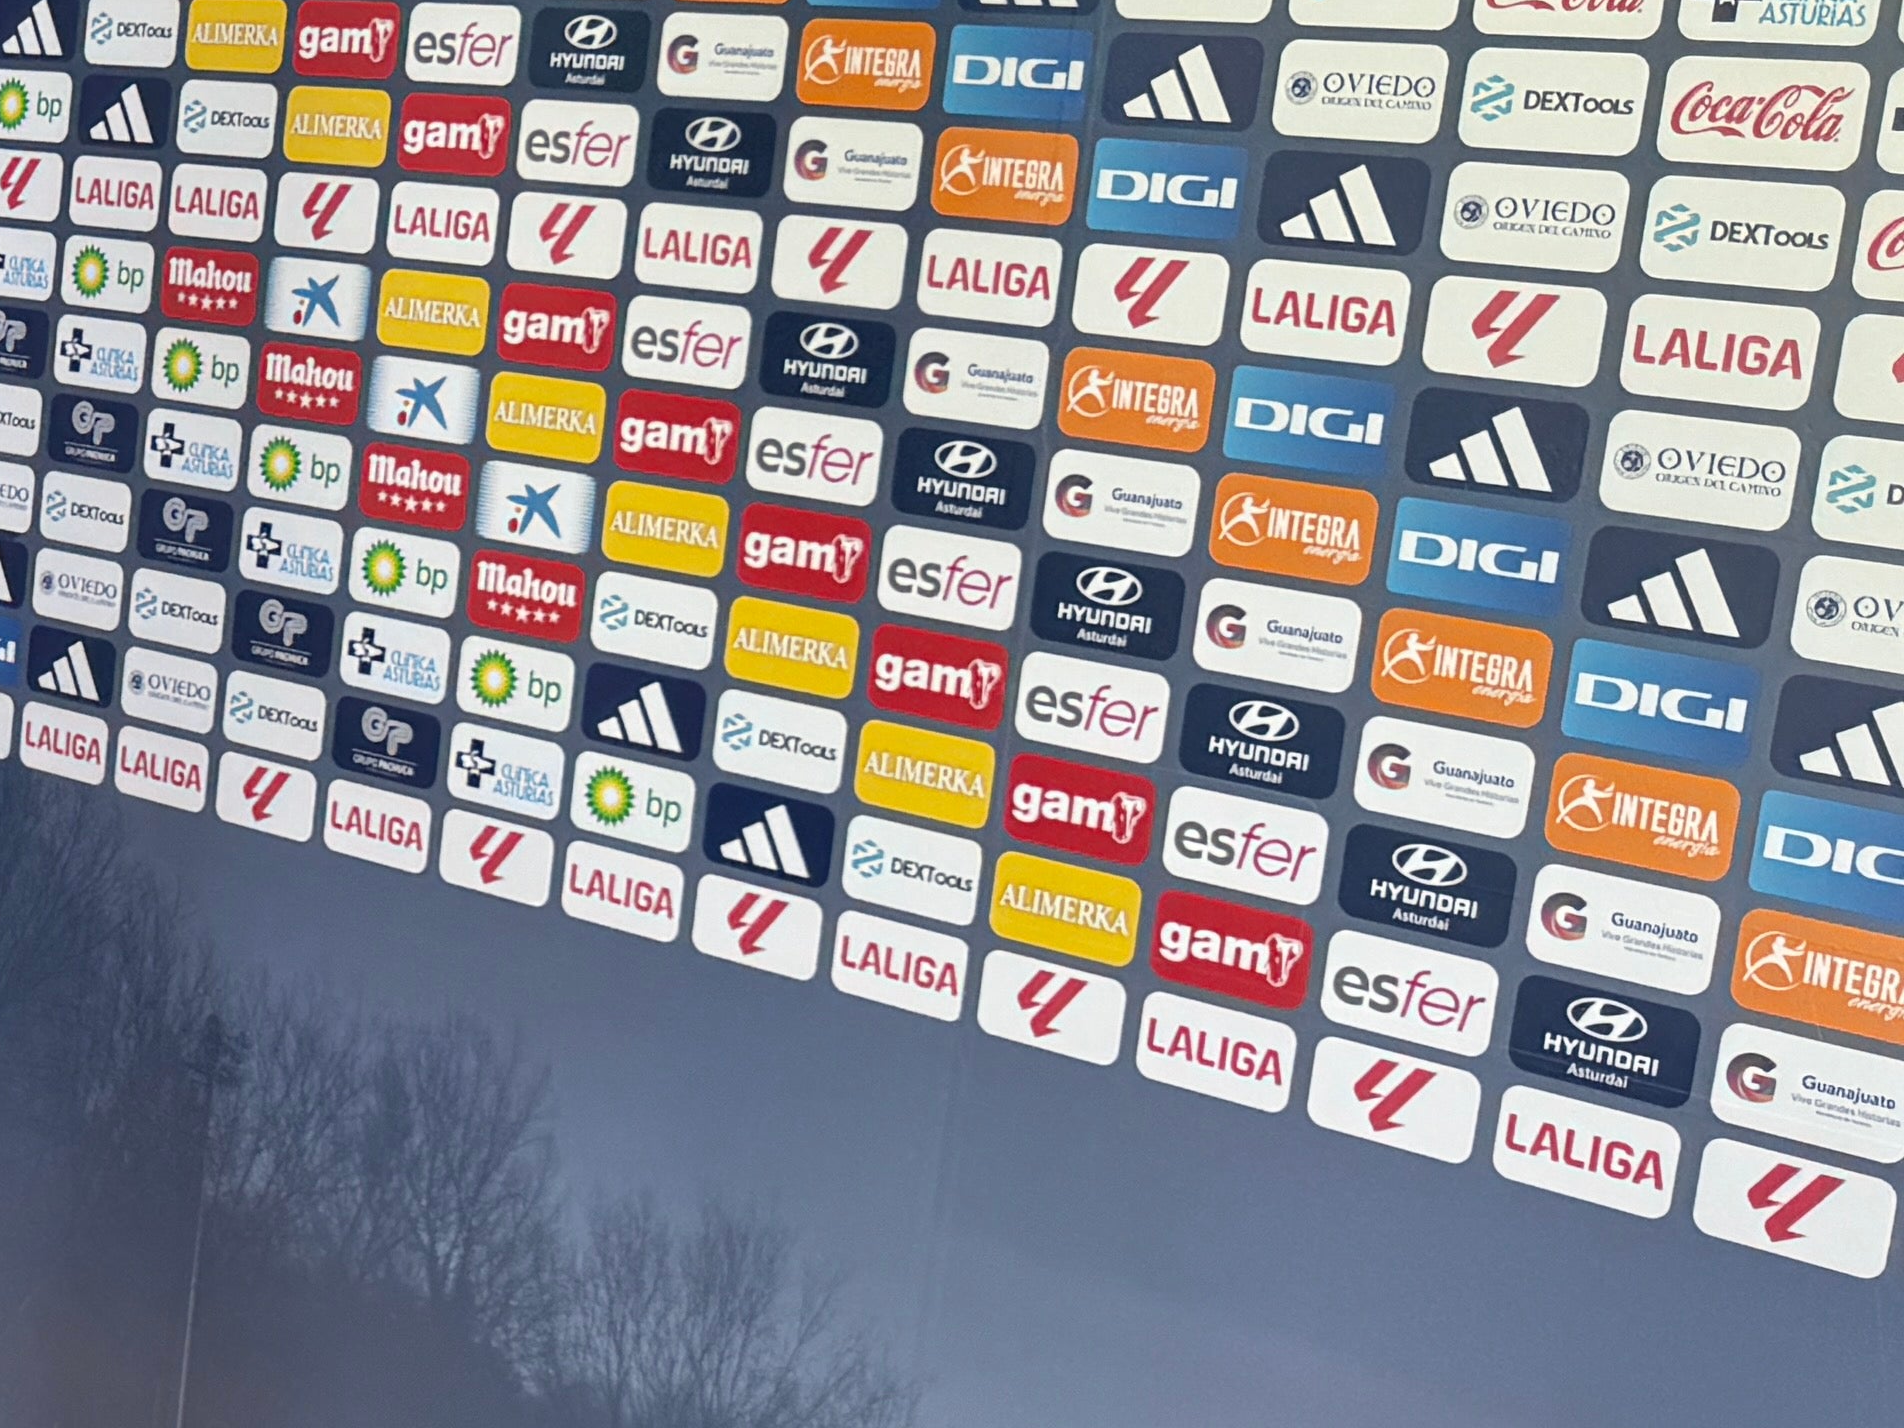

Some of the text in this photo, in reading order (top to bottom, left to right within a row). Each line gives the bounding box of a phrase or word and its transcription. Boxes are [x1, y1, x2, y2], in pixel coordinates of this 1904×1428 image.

[191, 21, 279, 47] ALIMERKA
[412, 22, 513, 67] esfer
[549, 51, 624, 71] HYUNDAI
[952, 54, 1085, 91] DIGI
[1323, 72, 1435, 98] OVIEDO
[289, 112, 382, 140] ALIMERKA
[524, 120, 630, 168] esfer
[669, 153, 749, 175] HYUNDAI
[981, 156, 1064, 192] INTEGRA
[74, 175, 154, 211] LALIGA
[174, 184, 258, 221] LALIGA
[394, 204, 489, 242] LALIGA
[643, 227, 752, 268] LALIGA
[168, 255, 251, 294] Mahou
[927, 255, 1050, 300] LALIGA
[1252, 287, 1395, 337] LALIGA
[265, 351, 353, 393] Mahou
[1633, 324, 1802, 380] LALIGA
[493, 400, 597, 436] ALIMERKA
[1111, 378, 1198, 419] INTEGRA
[1234, 397, 1384, 445] DIGI
[754, 433, 874, 485] esfer
[1657, 447, 1786, 483] OVIEDO
[916, 476, 1006, 505] HYUNDAI
[609, 509, 719, 549] ALIMERKA
[415, 557, 448, 596] bp
[1398, 530, 1559, 584] DIGI
[477, 559, 576, 608] Mahou
[887, 555, 1012, 609] esfer
[1057, 601, 1152, 634] HYUNDAI
[1433, 644, 1533, 693] INTEGRA
[1574, 672, 1748, 733] DIGI
[24, 720, 101, 766] LALIGA
[120, 745, 201, 792] LALIGA
[863, 751, 986, 799] ALIMERKA
[330, 800, 423, 852] LALIGA
[645, 787, 682, 829] bp
[1611, 791, 1719, 845] INTEGRA
[1173, 820, 1317, 882] esfer
[999, 883, 1130, 936] ALIMERKA
[1370, 878, 1479, 919] HYUNDAI
[1332, 965, 1486, 1032] esfer
[1543, 1032, 1660, 1077] HYUNDAI
[1505, 1113, 1663, 1191] LALIGA
